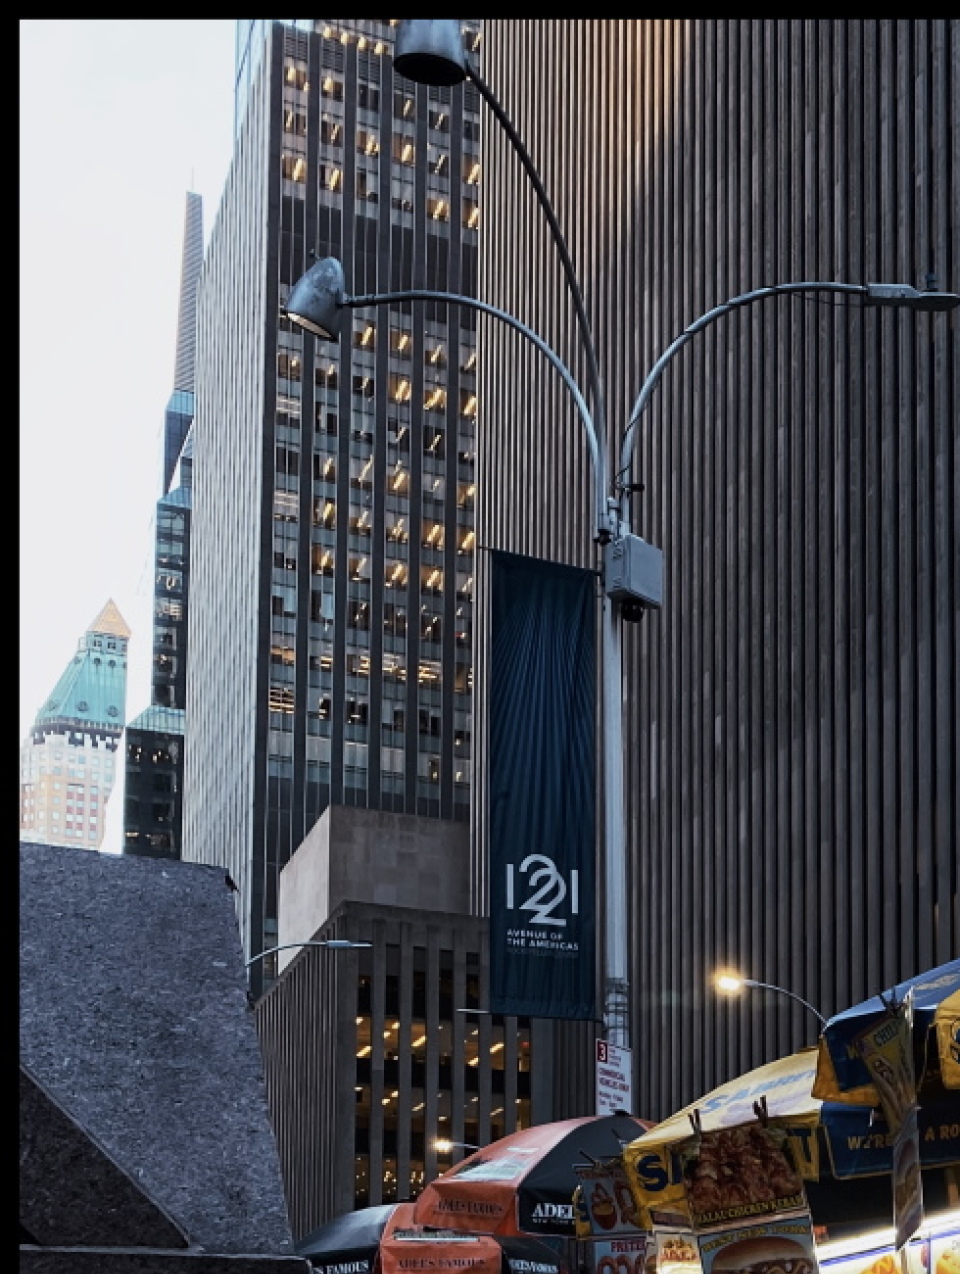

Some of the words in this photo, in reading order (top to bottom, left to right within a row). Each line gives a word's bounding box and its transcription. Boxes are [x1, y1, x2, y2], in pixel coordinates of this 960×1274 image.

[507, 854, 579, 926] 1221
[507, 929, 547, 939] AVENUE
[550, 931, 563, 940] OF
[507, 938, 526, 947] THE
[529, 940, 579, 951] AMERICAS
[598, 1043, 606, 1061] 3
[532, 1203, 577, 1218] ADEL
